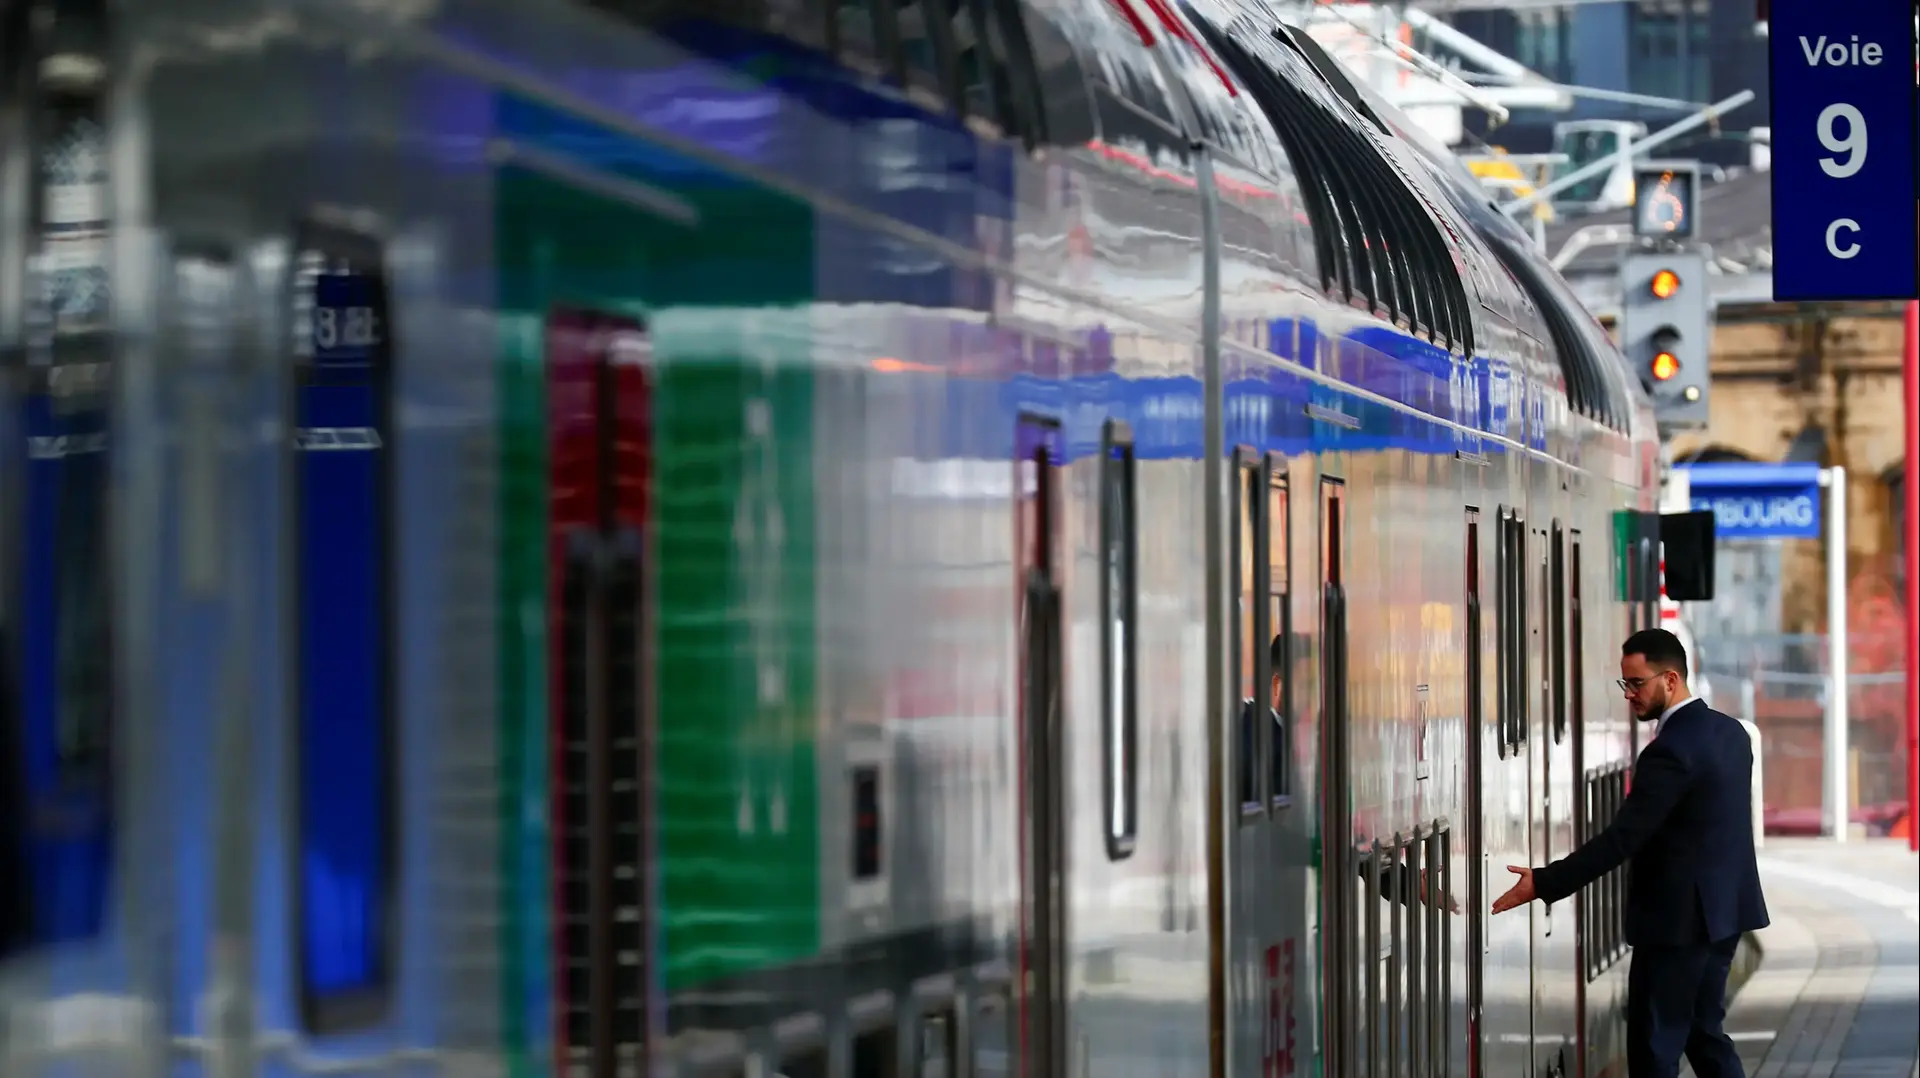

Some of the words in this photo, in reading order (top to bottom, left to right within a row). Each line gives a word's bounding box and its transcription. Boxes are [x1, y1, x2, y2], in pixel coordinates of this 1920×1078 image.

[1799, 35, 1883, 66] Voie
[1816, 103, 1868, 178] 9
[1649, 170, 1683, 231] 6
[1825, 218, 1861, 259] C
